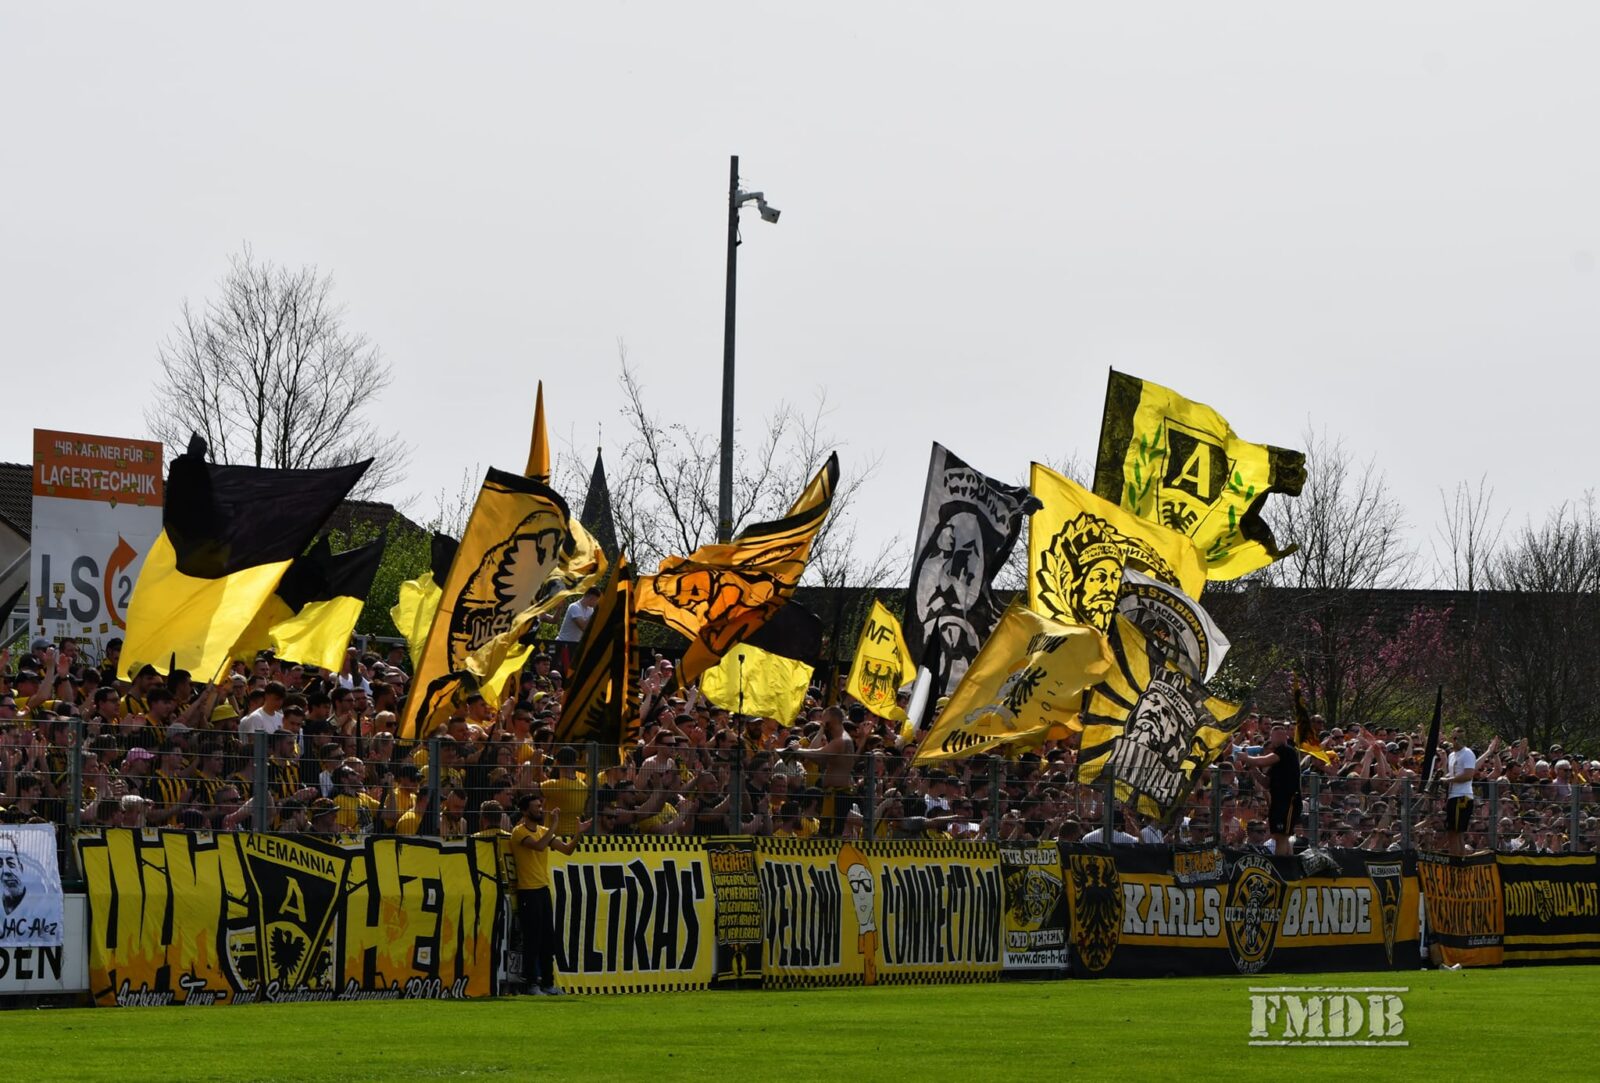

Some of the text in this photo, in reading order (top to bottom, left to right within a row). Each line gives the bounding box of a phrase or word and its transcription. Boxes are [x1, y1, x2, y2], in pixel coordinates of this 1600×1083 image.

[123, 445, 143, 462] FÜR
[1171, 442, 1211, 499] A
[41, 463, 156, 495] LAGERTECHNIK
[41, 554, 101, 623] LS
[246, 833, 336, 877] ALEMANNIA
[1024, 848, 1057, 865] STADT
[278, 875, 307, 923] A
[550, 859, 706, 974] ULTRAS
[760, 861, 1005, 967] YELLOW CONNECTION
[1122, 882, 1372, 937] KARLS BANDE
[1504, 880, 1537, 917] DOM
[1551, 880, 1599, 917] WACHT
[1008, 928, 1065, 948] UND VEREIN
